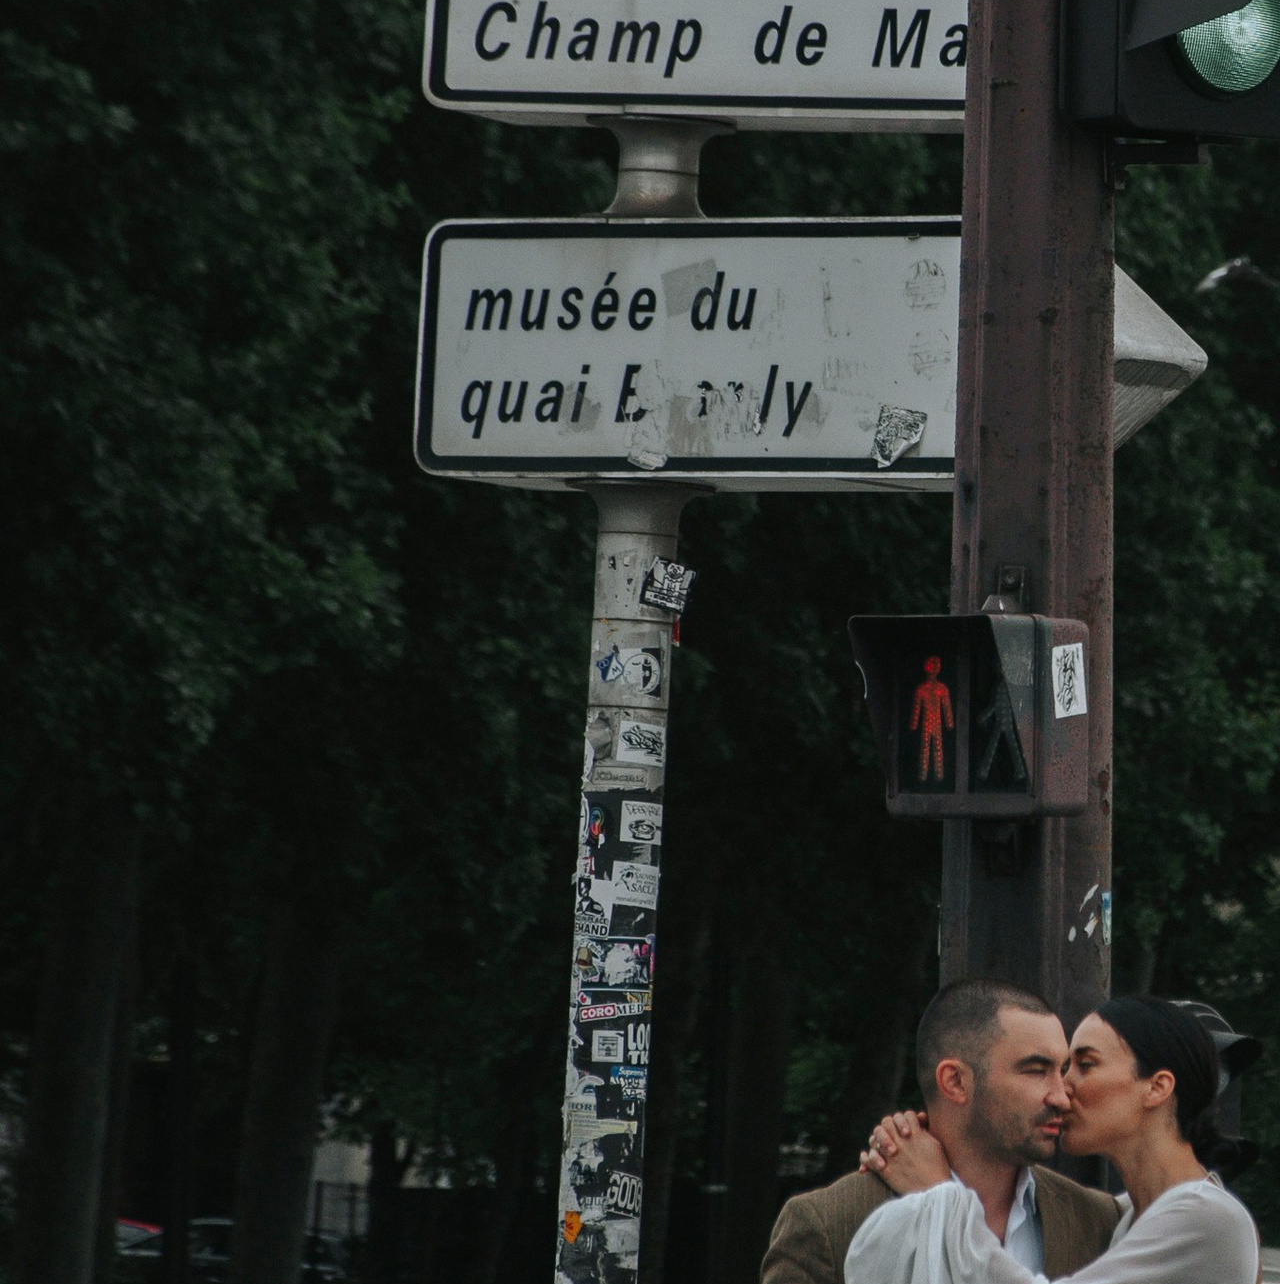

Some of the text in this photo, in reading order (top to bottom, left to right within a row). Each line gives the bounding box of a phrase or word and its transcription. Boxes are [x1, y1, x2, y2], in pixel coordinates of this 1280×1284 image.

[475, 1, 703, 78] Champ
[754, 5, 829, 67] de
[465, 271, 758, 332] musée du
[460, 365, 592, 439] quai
